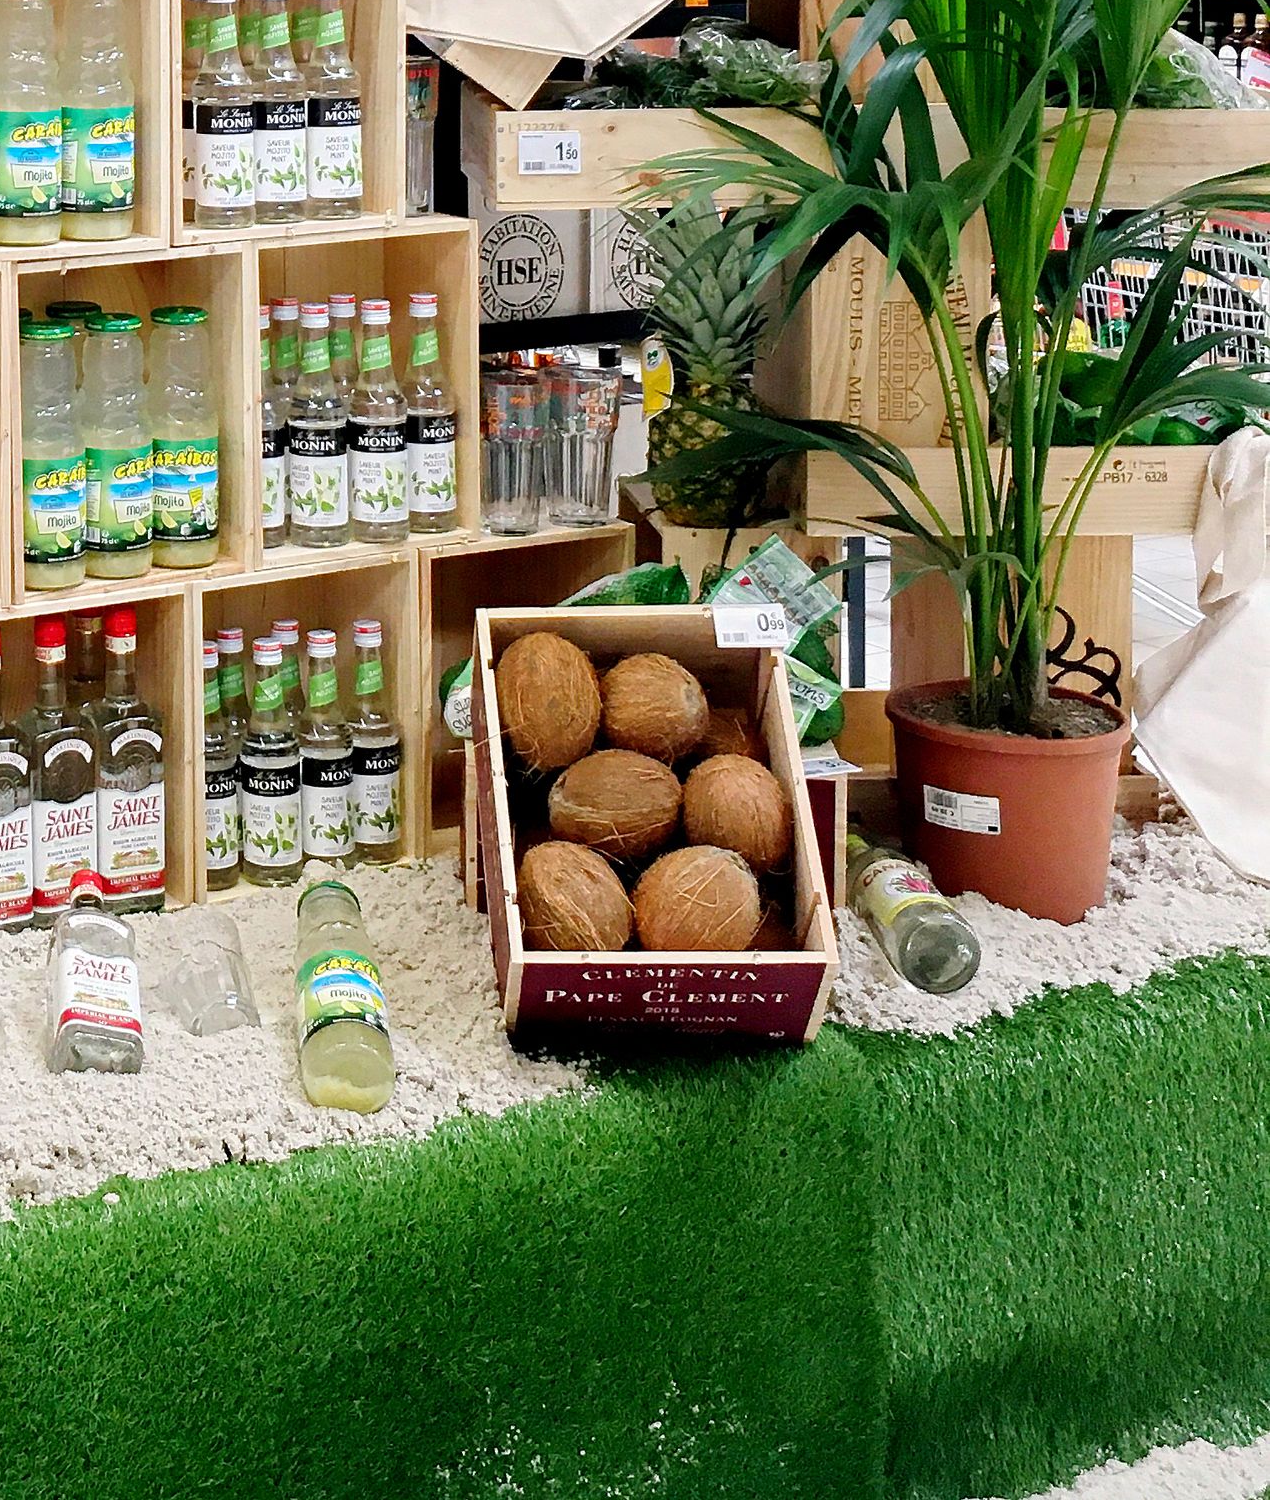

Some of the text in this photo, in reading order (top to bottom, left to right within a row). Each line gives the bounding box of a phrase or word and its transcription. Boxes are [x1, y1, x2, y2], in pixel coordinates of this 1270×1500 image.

[211, 118, 253, 129] MONIN
[554, 141, 578, 161] 1 50
[24, 171, 53, 183] Mojito
[480, 216, 559, 264] HABITATION
[496, 256, 542, 286] HSE
[847, 255, 864, 350] MOULIS
[291, 439, 336, 451] MONIN
[358, 435, 404, 449] MONIN
[1144, 470, 1168, 483] 6328
[757, 613, 785, 632] 0 99
[248, 777, 295, 791] MONIN
[112, 795, 160, 815] SAINT
[45, 805, 93, 826] SAINT
[107, 810, 161, 831] JAMES
[41, 821, 94, 843] JAMES
[544, 988, 790, 1004] PAPE CLEMENT
